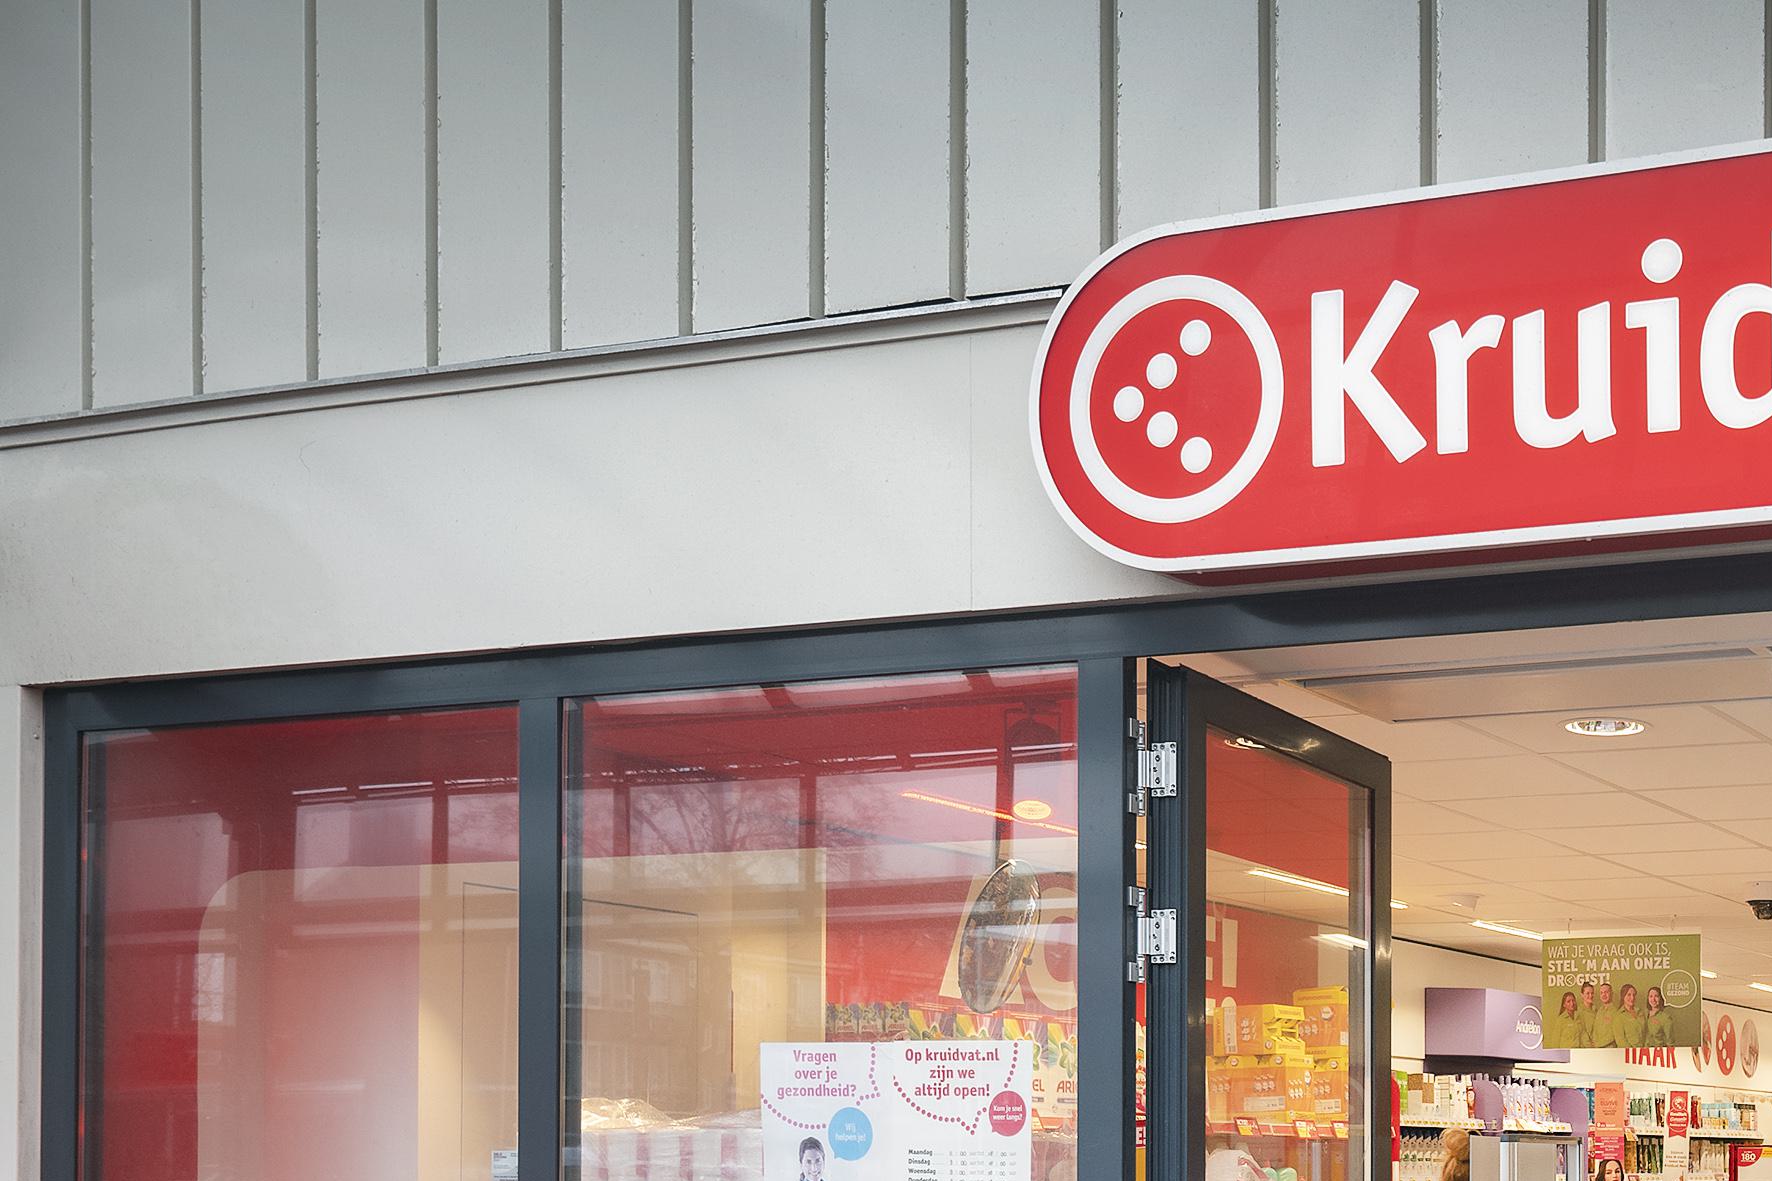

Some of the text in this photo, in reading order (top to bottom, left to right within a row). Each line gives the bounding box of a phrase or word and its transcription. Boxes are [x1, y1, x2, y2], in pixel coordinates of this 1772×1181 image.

[1548, 942, 1671, 958] WAT JE VRAAG OOK IS,
[1548, 960, 1578, 972] STEL
[1601, 958, 1630, 970] AAN
[1634, 957, 1670, 969] ONZE
[793, 1050, 837, 1064] Vragen
[905, 1048, 999, 1063] Op kruidvat.nl
[794, 1068, 838, 1082] over je
[929, 1066, 976, 1082] zijn we
[777, 1084, 857, 1099] gezondheid?
[914, 1084, 990, 1099] altijd open!
